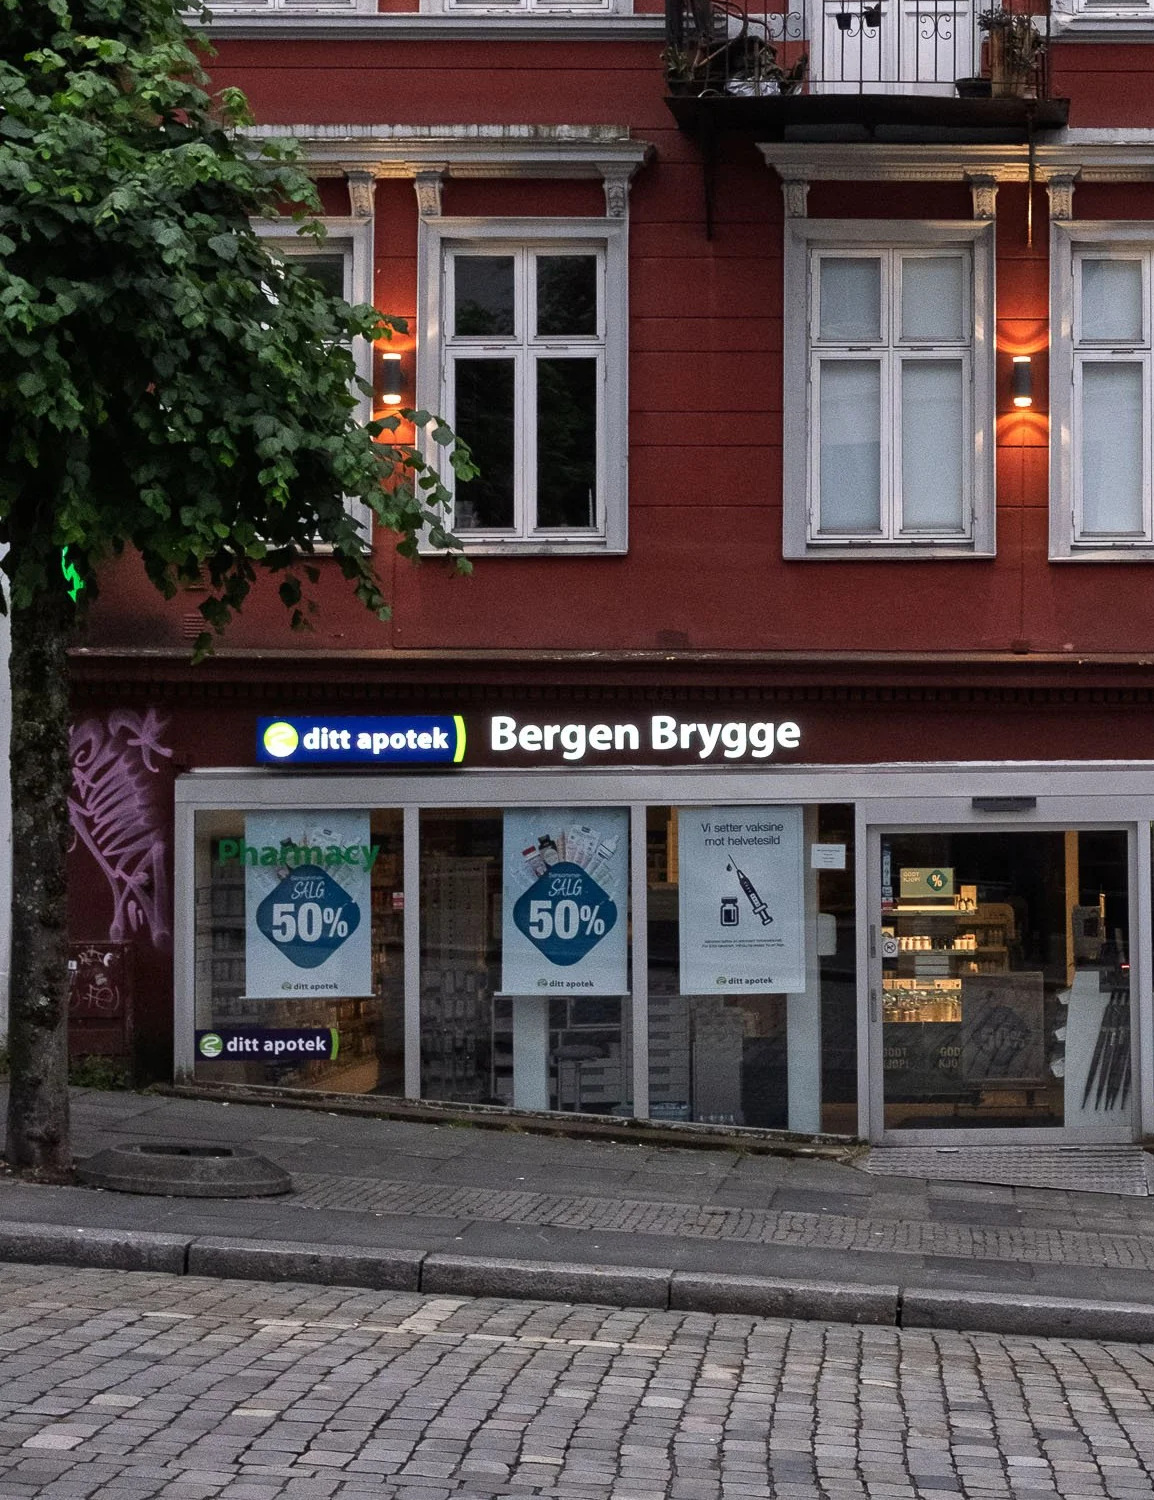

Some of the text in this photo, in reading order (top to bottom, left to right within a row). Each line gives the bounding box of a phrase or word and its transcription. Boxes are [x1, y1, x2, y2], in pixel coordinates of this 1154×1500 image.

[303, 727, 449, 754] ditt apotek
[490, 714, 801, 760] Bergen Brygge
[701, 822, 784, 833] Vi setter vaksine
[704, 836, 781, 846] mot helvetesild
[218, 838, 381, 873] Pharmacy
[290, 880, 326, 900] SALG
[548, 878, 583, 897] SALG
[271, 901, 349, 943] 50%
[528, 899, 606, 940] 50%
[310, 982, 338, 990] apotek
[566, 980, 594, 988] apotek
[745, 977, 773, 985] apotek
[226, 1036, 327, 1055] ditt apotek
